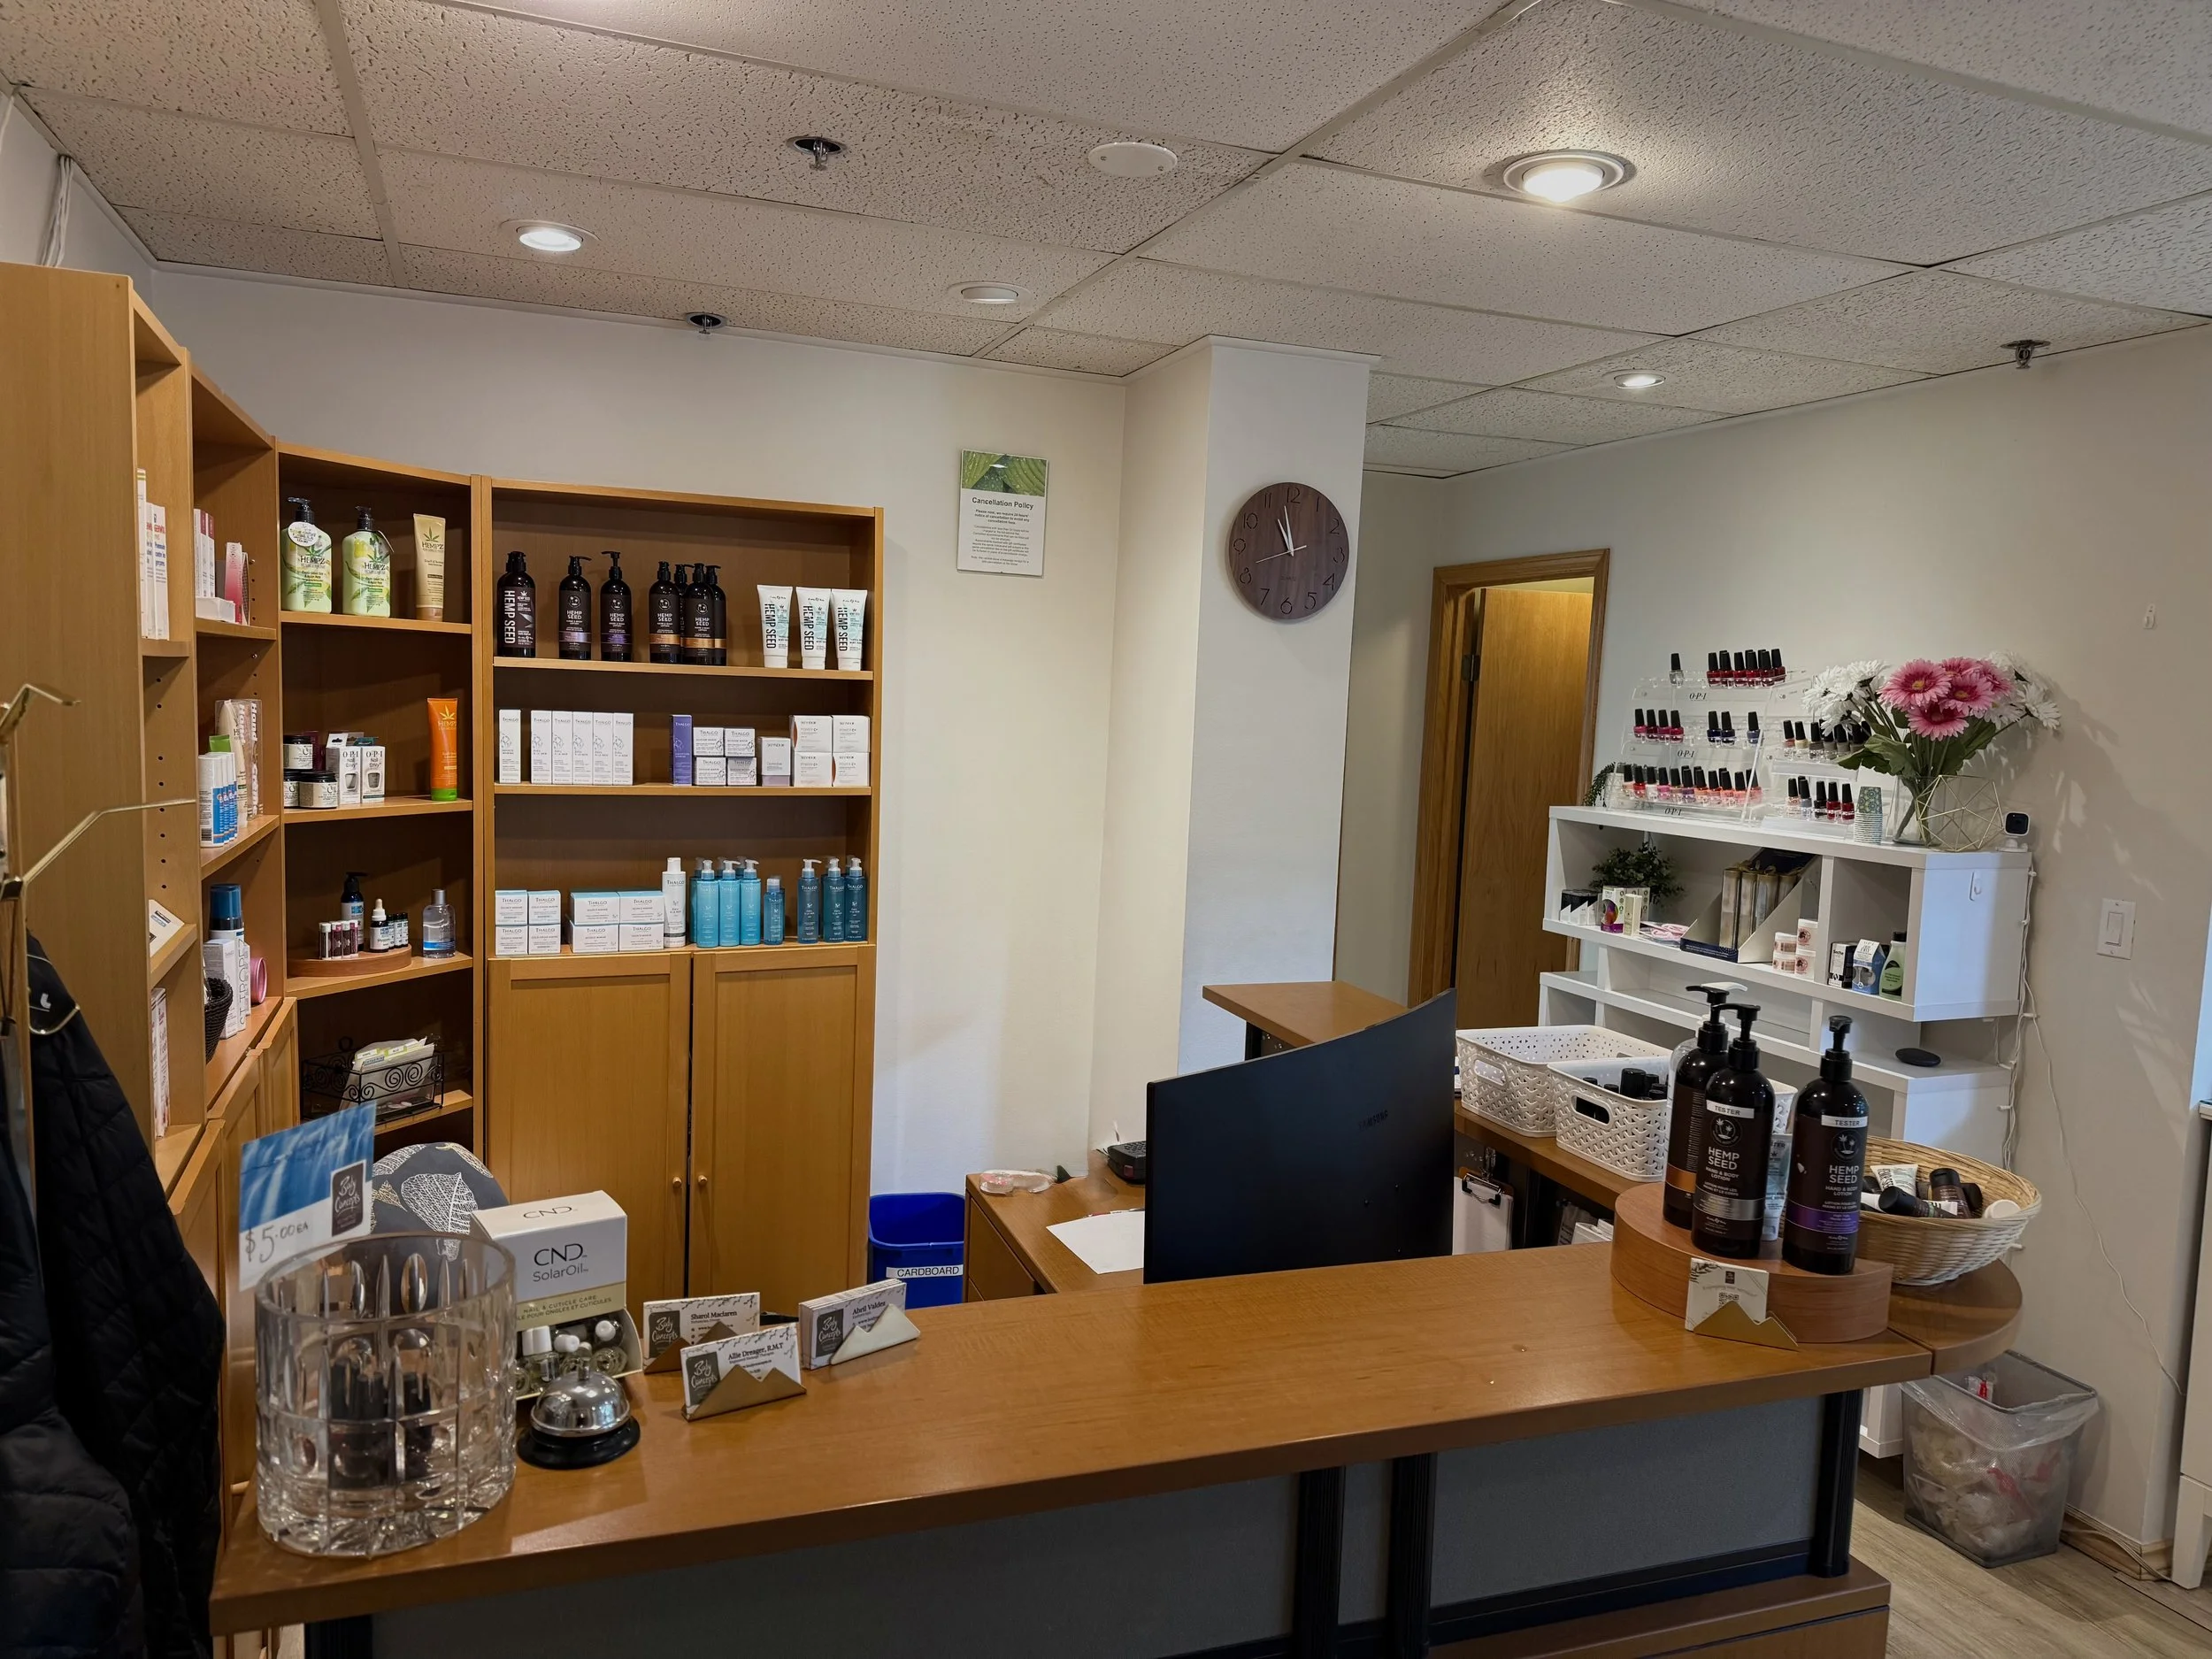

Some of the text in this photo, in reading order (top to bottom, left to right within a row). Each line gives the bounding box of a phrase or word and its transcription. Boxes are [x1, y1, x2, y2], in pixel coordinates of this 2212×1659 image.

[1264, 492, 1272, 509] 11
[1286, 487, 1301, 503] 12
[972, 496, 1034, 511] Cancellation Policy
[1243, 512, 1258, 529] 10
[1329, 518, 1340, 535] 2
[421, 541, 444, 549] HEMPZ
[1233, 538, 1247, 555] 9
[300, 555, 326, 565] HEMPZ
[1333, 547, 1346, 564] 3
[364, 561, 386, 571] HEMPZ
[1240, 567, 1252, 584] 8
[1323, 572, 1335, 591] 4
[1260, 588, 1271, 606] 7
[1304, 591, 1317, 610] 5
[1280, 596, 1293, 615] 6
[503, 590, 516, 644] HEMP SEED
[764, 603, 777, 649] HEMP SEED
[803, 605, 814, 650] HEMP SEED
[837, 607, 849, 651] HEMP SEED
[1714, 1105, 1741, 1116] TESTER
[1708, 1146, 1740, 1161] HEMP
[1705, 1166, 1719, 1175] HAND
[1708, 1156, 1738, 1171] SEED
[1829, 1164, 1860, 1175] HEMP
[1710, 1173, 1731, 1182] LOTION
[1829, 1174, 1858, 1184] SEED
[339, 1175, 357, 1197] Body
[334, 1192, 361, 1213] Concepts
[523, 1206, 573, 1219] CND
[534, 1243, 585, 1266] CND
[533, 1263, 584, 1283] SolarOil
[896, 1266, 959, 1278] CARDBOARD
[545, 1306, 570, 1316] ONGLES
[580, 1297, 612, 1309] CUTICULES
[549, 1299, 577, 1309] CUTICLE
[579, 1294, 597, 1303] CARE
[852, 1305, 867, 1316] Abril
[656, 1316, 673, 1333] Body
[822, 1317, 837, 1332] Body
[651, 1330, 678, 1343] Concepts
[818, 1329, 841, 1343] Concepts
[741, 1348, 767, 1358] Dreager,
[694, 1359, 712, 1377] Body
[691, 1374, 718, 1389] Concepts
